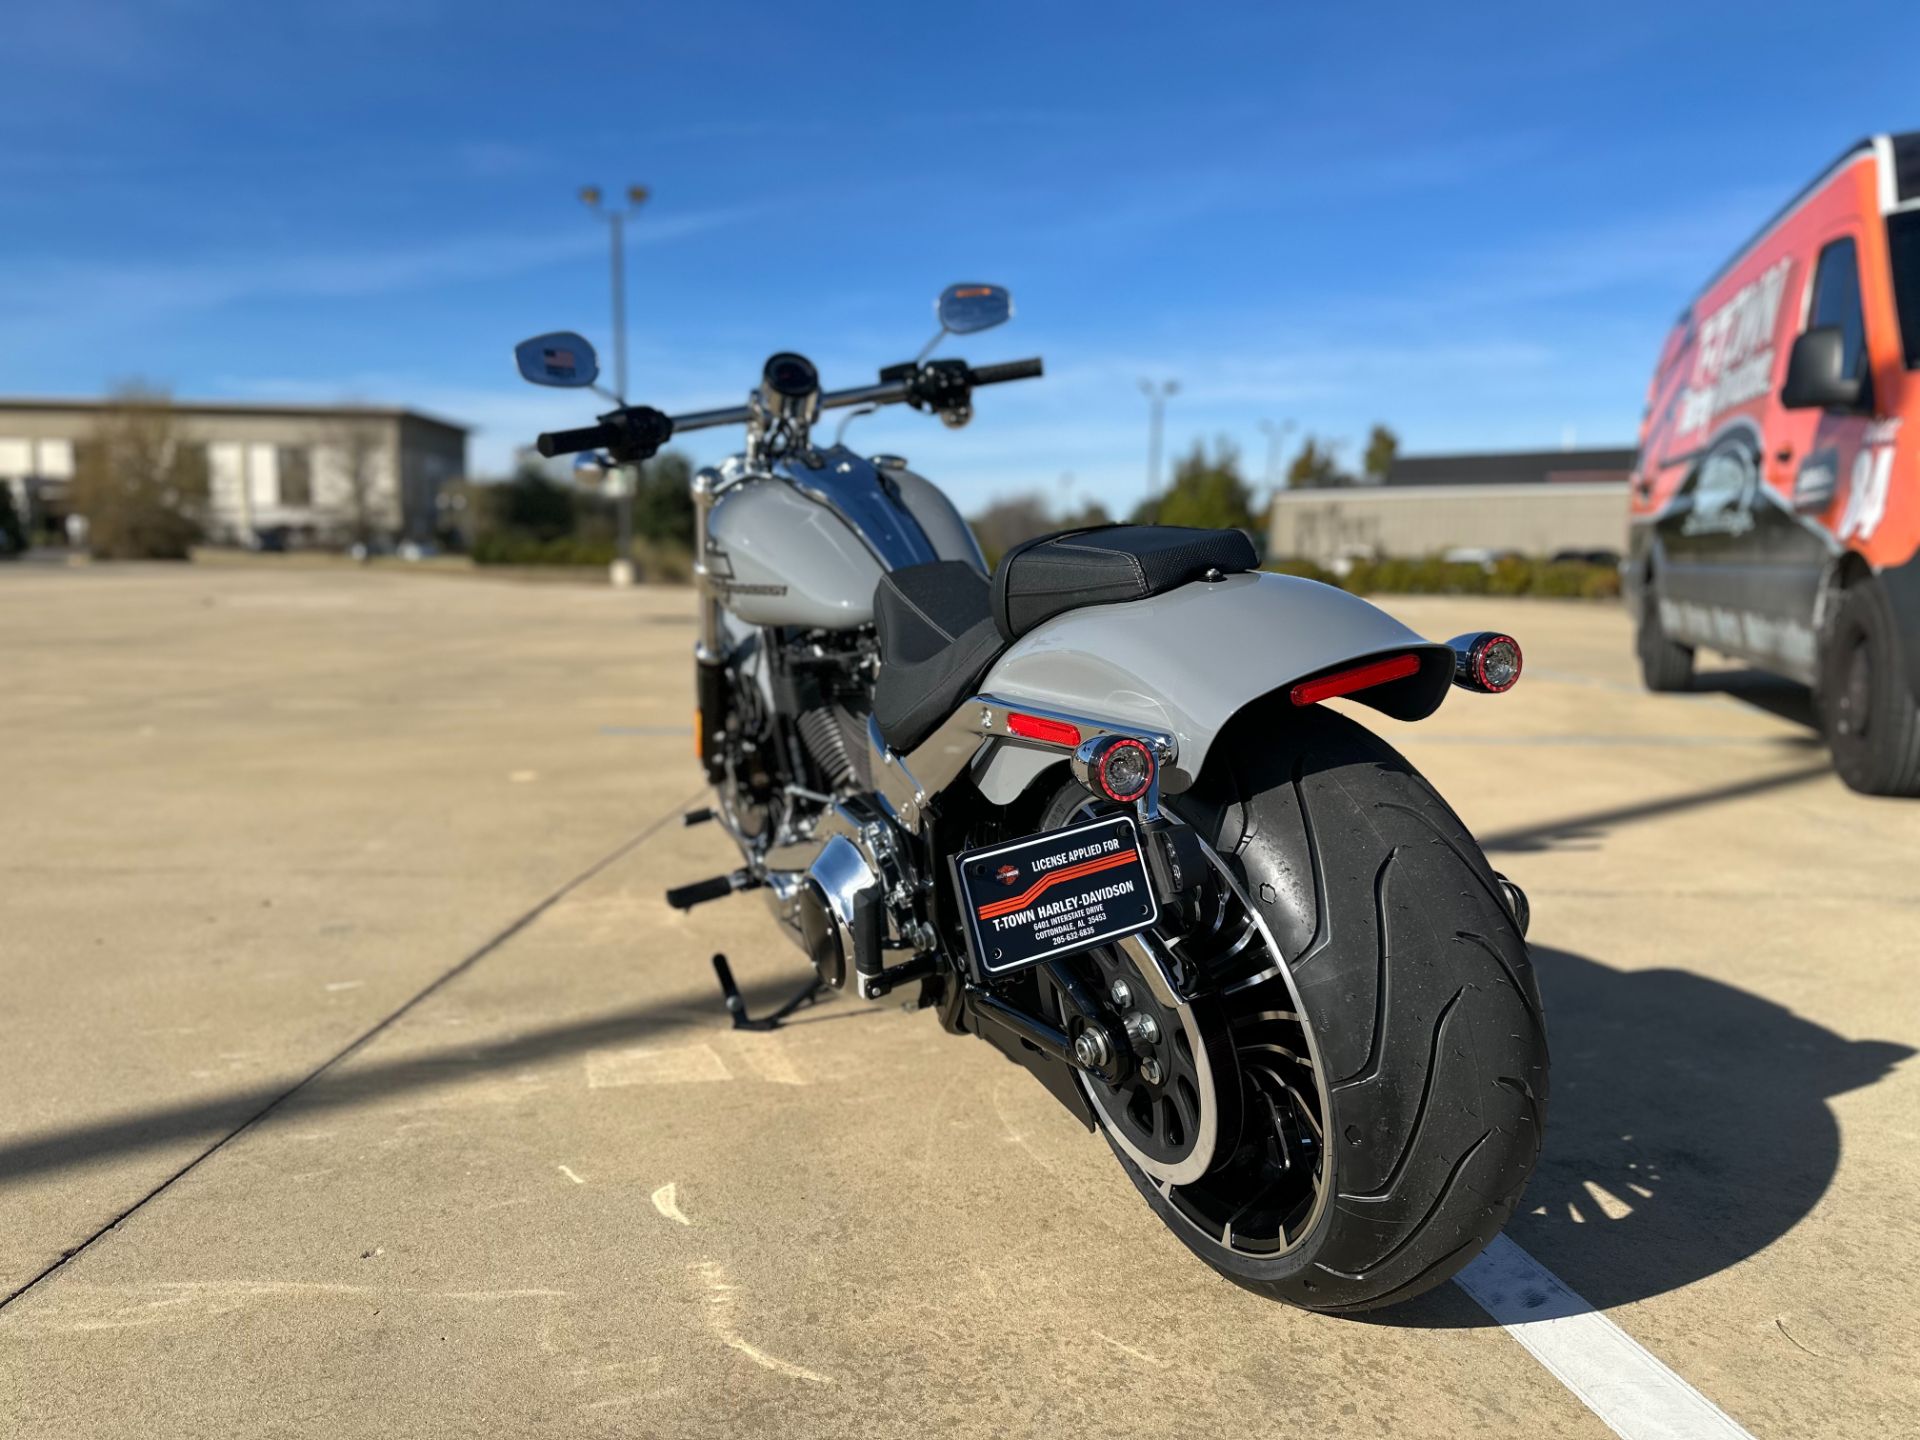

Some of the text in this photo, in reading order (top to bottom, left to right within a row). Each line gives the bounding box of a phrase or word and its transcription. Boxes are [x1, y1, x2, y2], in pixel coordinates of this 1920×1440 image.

[1031, 838, 1120, 872] LICENSE APPLIED FOR
[992, 880, 1135, 932] T-TOWN HARLEY-DAVIDSON
[1033, 904, 1104, 931] 6401 INTERSTATE DRIVE
[1034, 912, 1107, 940] COTTONDALE, AL 35453
[1052, 926, 1095, 945] 205-632-6835
